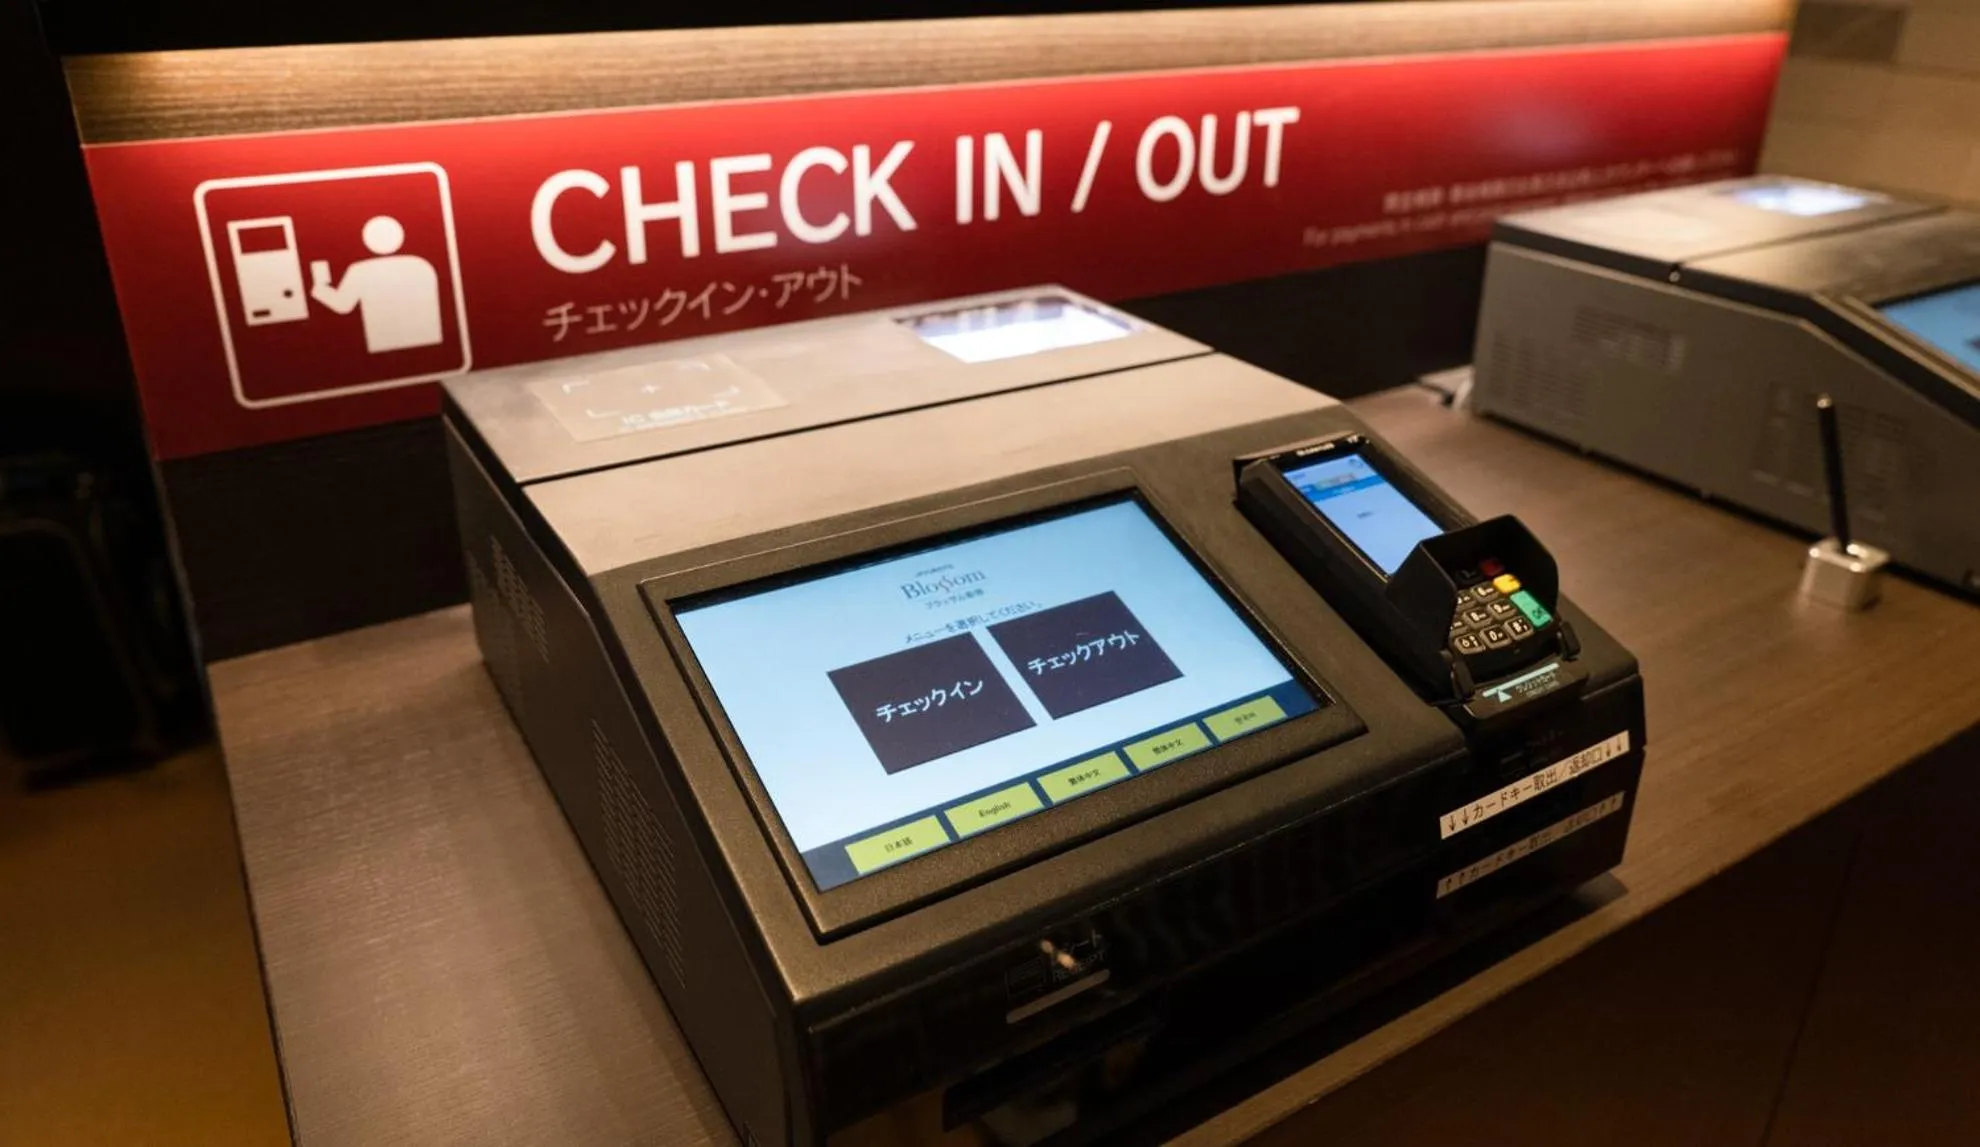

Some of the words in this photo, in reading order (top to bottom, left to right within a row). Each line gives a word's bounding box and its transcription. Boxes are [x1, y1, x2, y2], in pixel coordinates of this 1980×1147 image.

[530, 140, 918, 274] CHECK
[955, 128, 1043, 225] IN
[1070, 119, 1112, 213] /
[1135, 105, 1301, 202] OUT
[542, 263, 864, 342] チェックイン・アウト
[901, 570, 987, 600] Blossom
[905, 600, 1044, 643] メニューを選択してください。
[1027, 630, 1141, 675] チェックアウト
[875, 679, 984, 723] チェックイン
[978, 801, 1012, 819] English
[884, 836, 914, 853] 日本語
